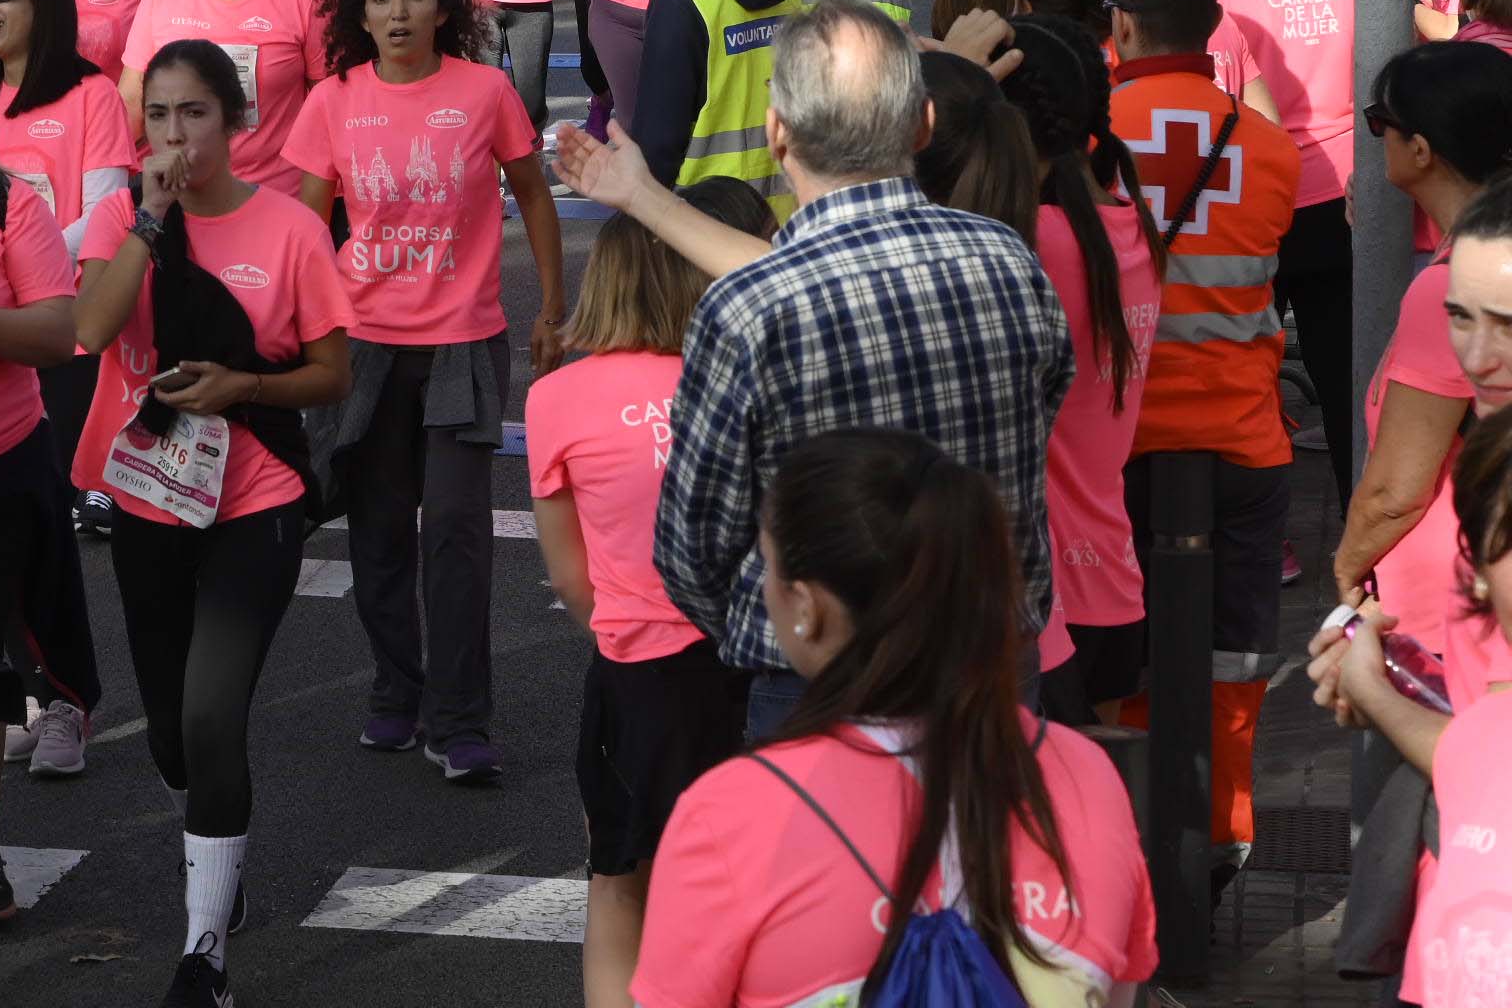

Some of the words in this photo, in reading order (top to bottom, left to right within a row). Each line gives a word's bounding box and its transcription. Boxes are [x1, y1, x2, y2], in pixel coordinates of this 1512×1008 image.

[1284, 4, 1305, 21] DE
[1312, 3, 1334, 21] LA
[1282, 17, 1340, 40] MUJER
[345, 115, 388, 129] OYSHO
[382, 225, 461, 241] DORSAL
[351, 241, 456, 274] SUMA
[159, 435, 188, 465] 016
[157, 455, 179, 478] 25912
[116, 469, 152, 493] OYSHO
